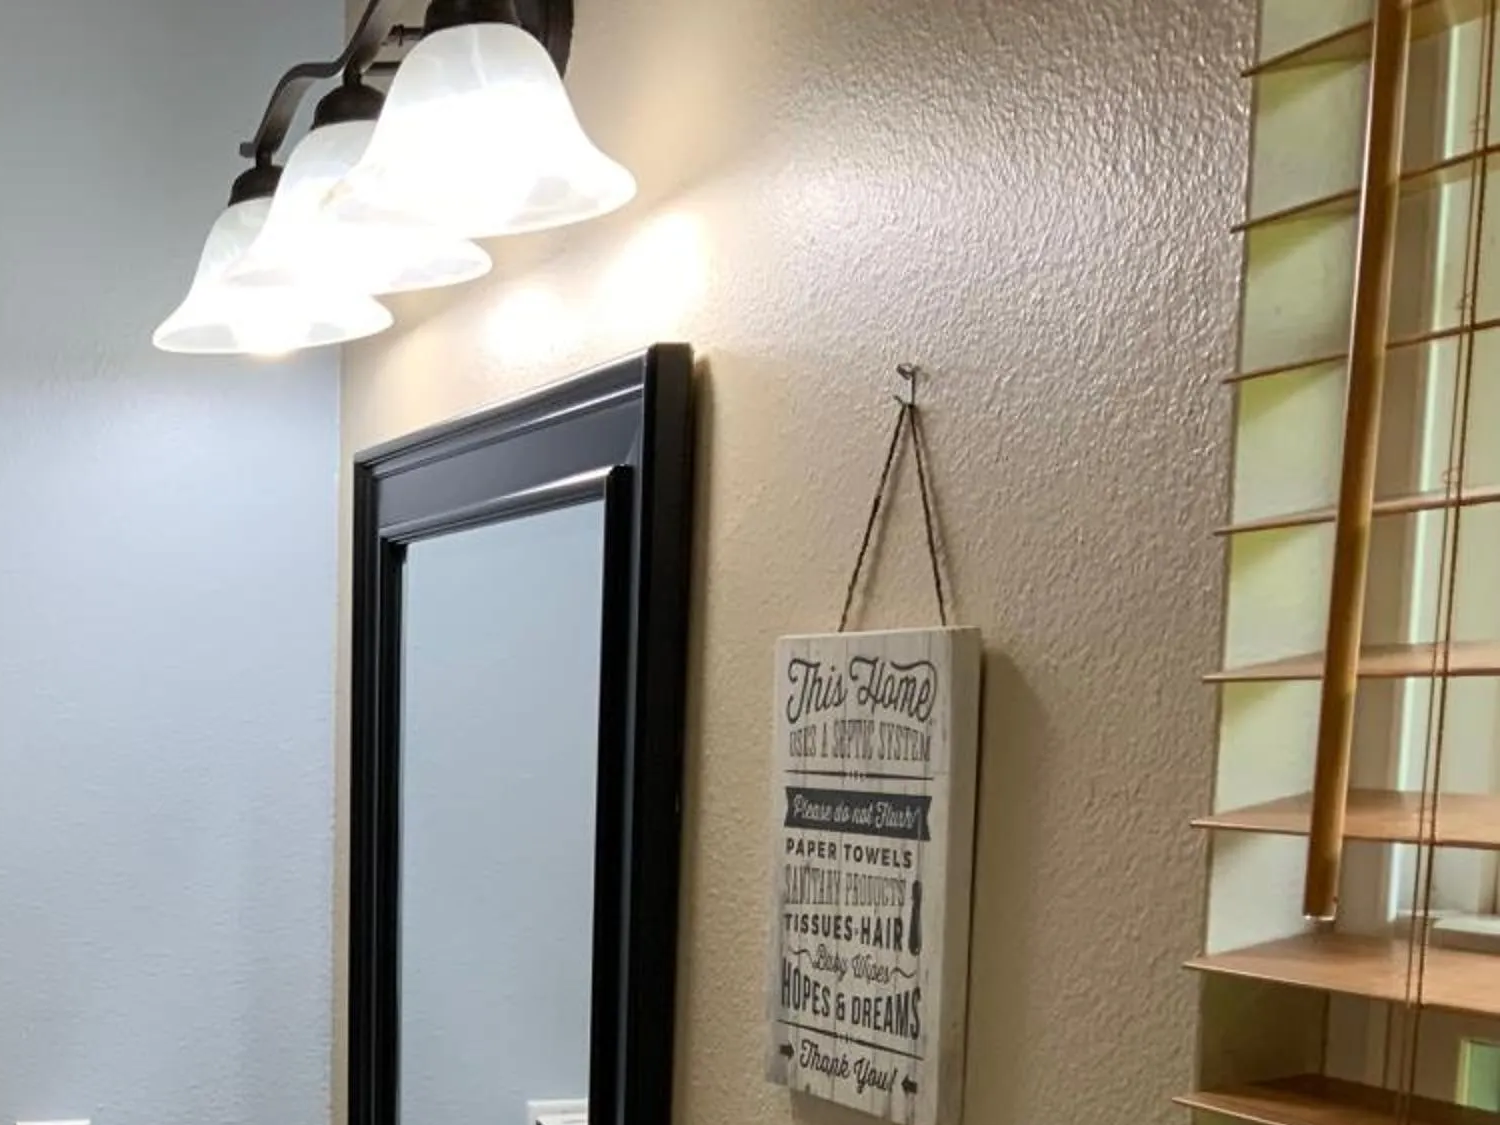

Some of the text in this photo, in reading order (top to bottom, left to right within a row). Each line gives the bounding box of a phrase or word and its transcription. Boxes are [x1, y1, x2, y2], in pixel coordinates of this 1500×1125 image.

[786, 655, 938, 724] This Home
[878, 720, 931, 762] SYSTEM
[793, 794, 832, 822] Please
[833, 800, 850, 824] do
[852, 803, 873, 826] not
[786, 837, 913, 869] PAPER TOWELS
[785, 864, 906, 907] SANITARY PRODUCTS
[812, 943, 891, 985] Baby Wipes
[782, 957, 921, 1041] HOPES & DREAMS
[799, 1038, 899, 1094] Thank You!
